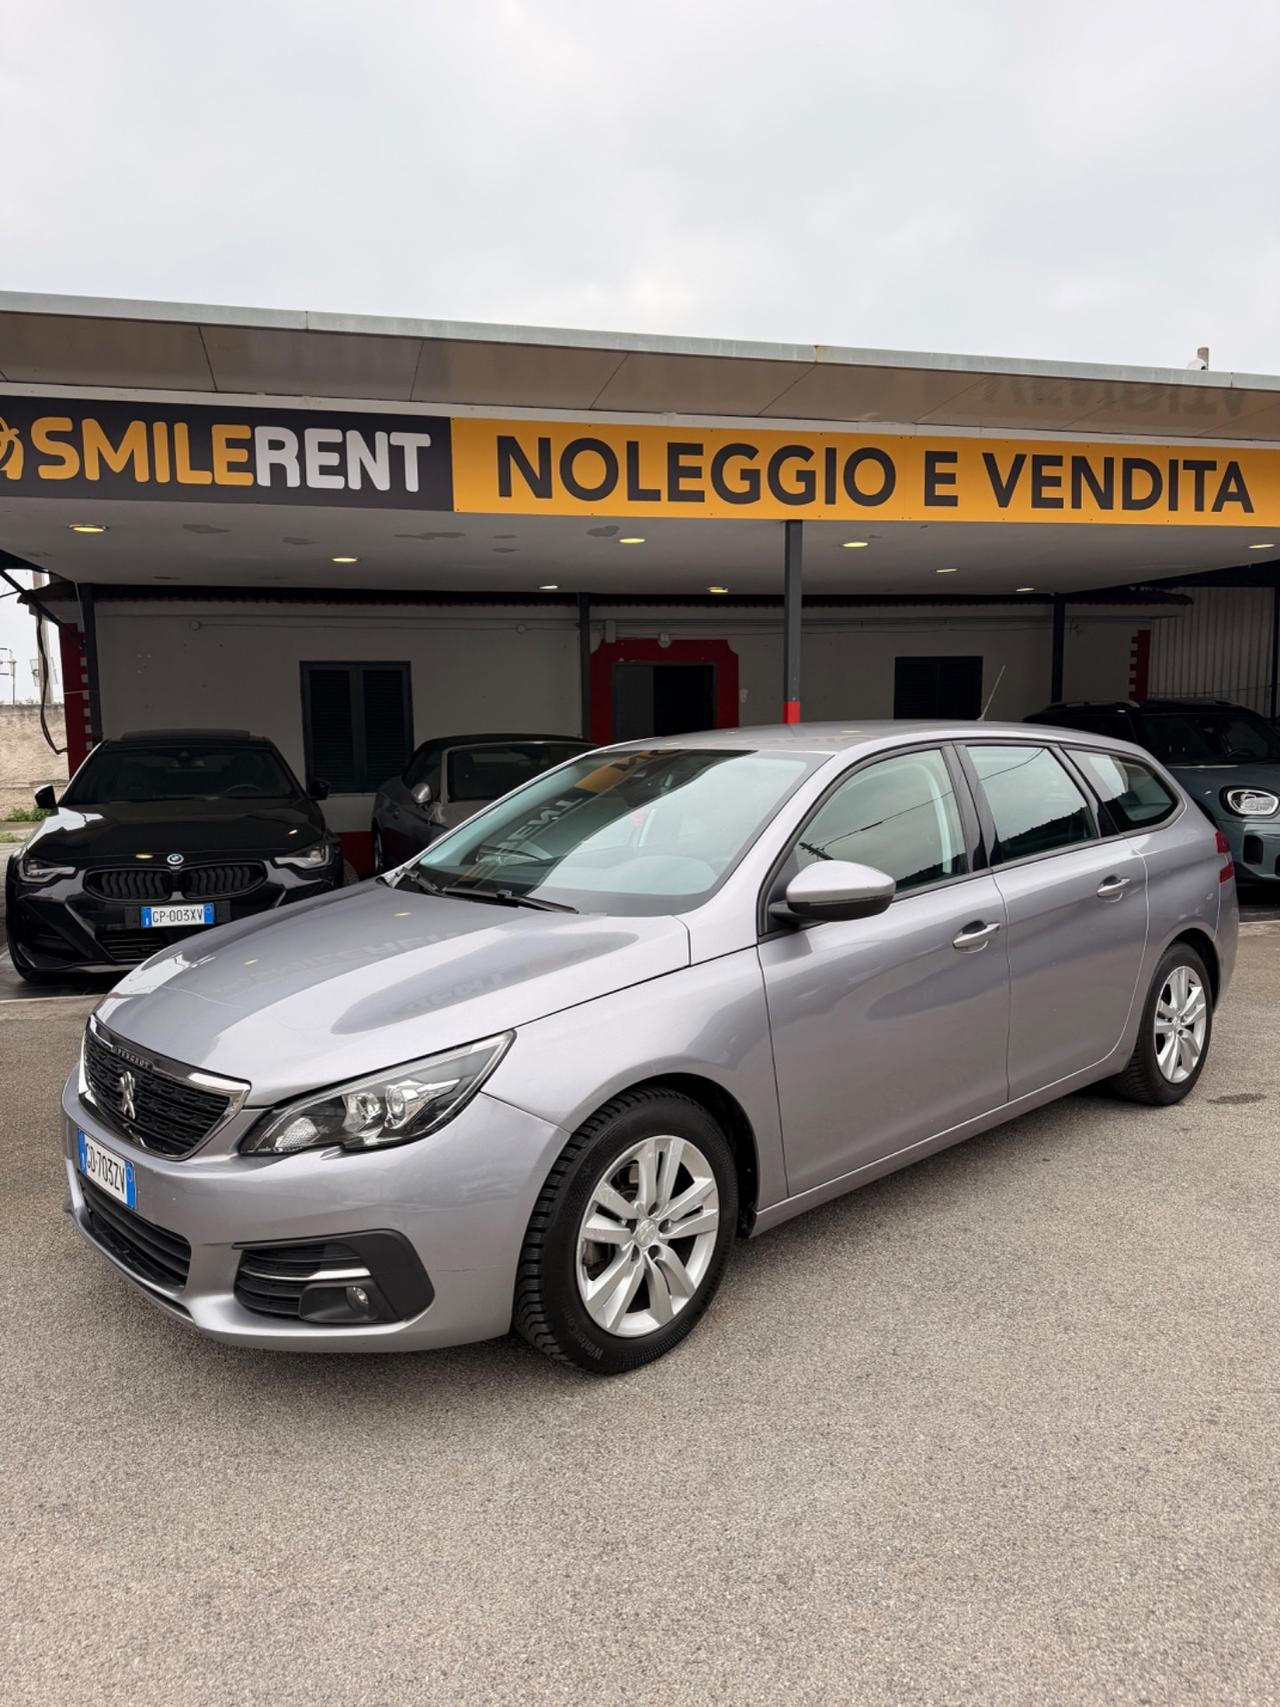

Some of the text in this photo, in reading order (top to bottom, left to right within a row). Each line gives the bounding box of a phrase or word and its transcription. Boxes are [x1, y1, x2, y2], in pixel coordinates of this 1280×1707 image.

[30, 416, 431, 492] SMILERENT
[497, 434, 1254, 514] NOLEGGIO E VENDITA
